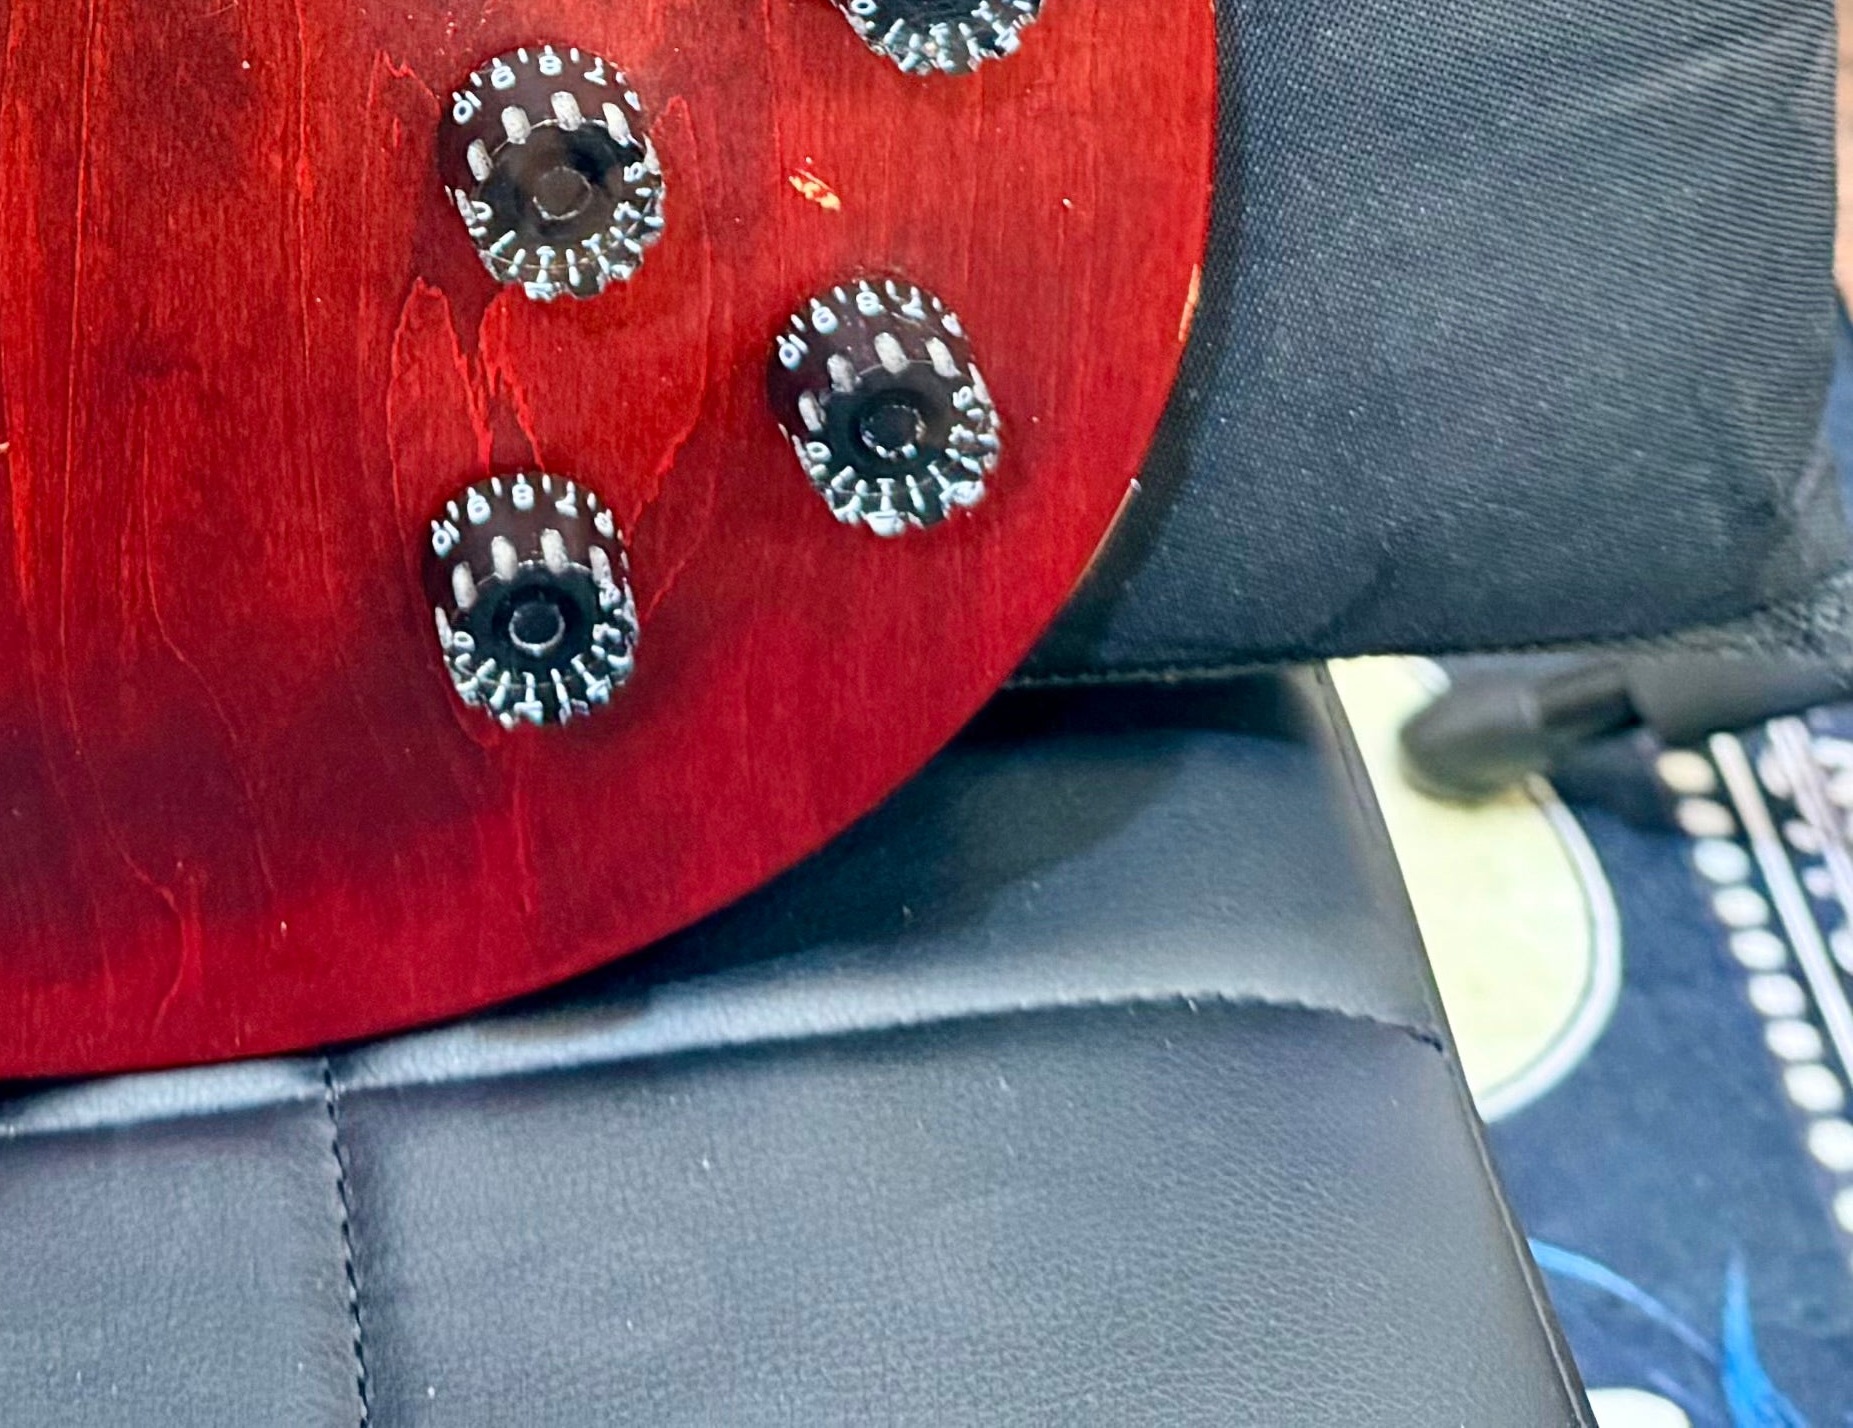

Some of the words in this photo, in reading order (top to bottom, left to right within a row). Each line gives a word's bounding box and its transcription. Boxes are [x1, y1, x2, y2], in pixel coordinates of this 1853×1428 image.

[539, 55, 562, 75] 8
[856, 290, 880, 316] 8
[512, 483, 535, 510] 8
